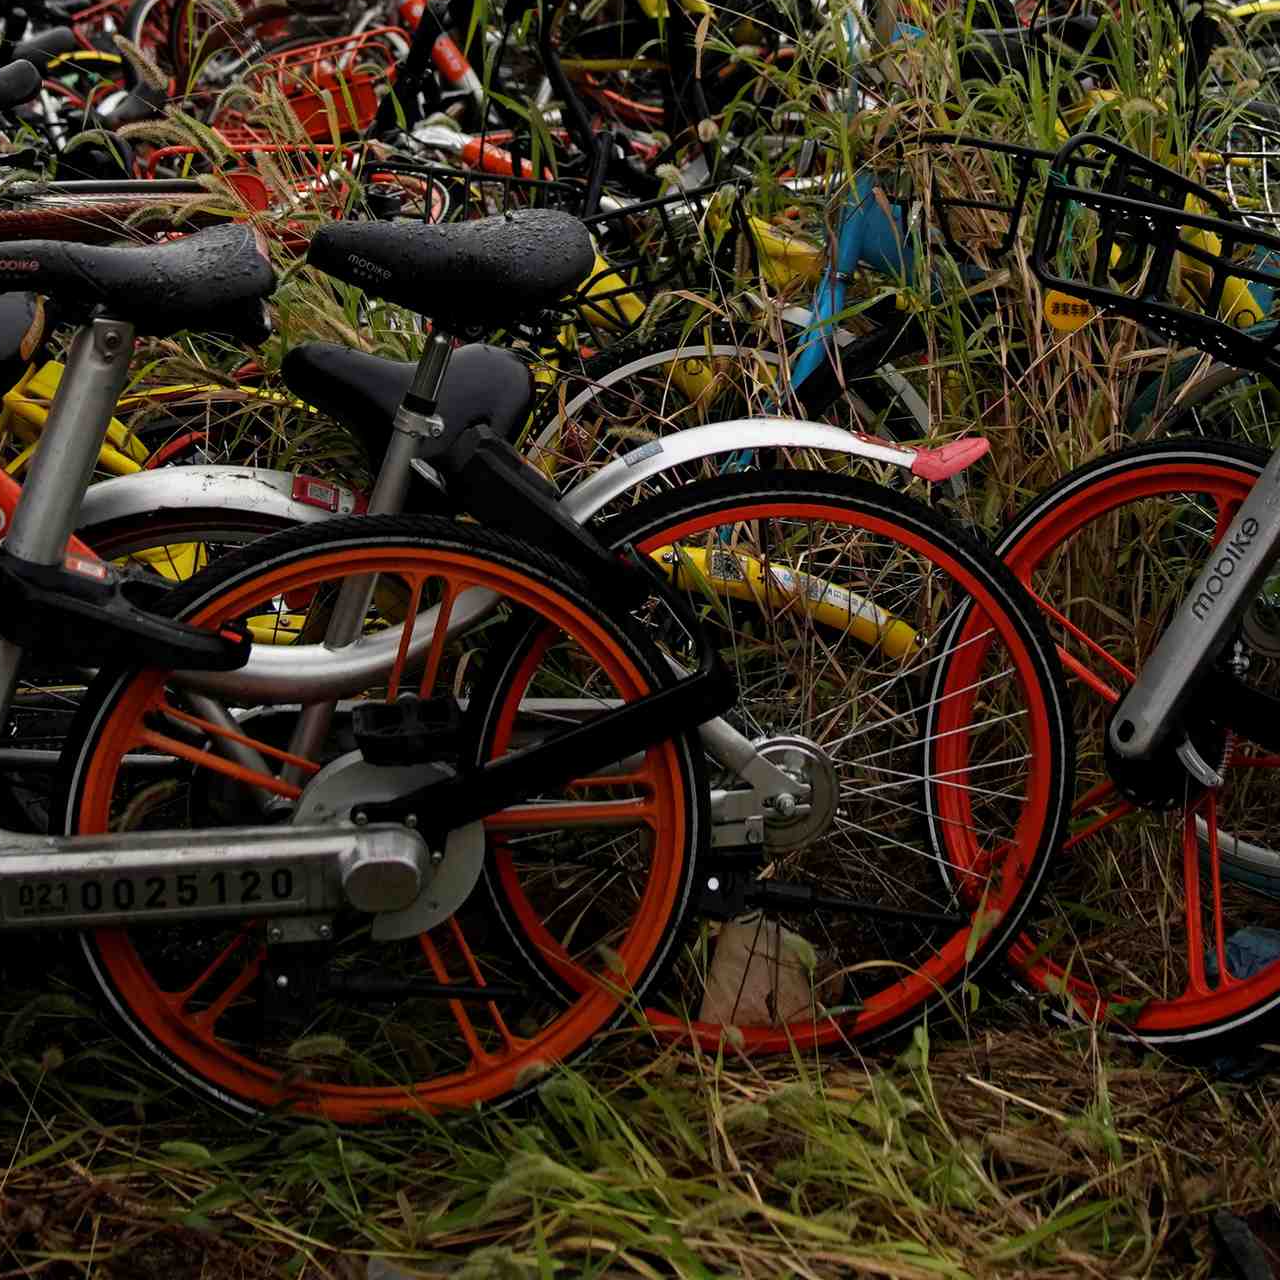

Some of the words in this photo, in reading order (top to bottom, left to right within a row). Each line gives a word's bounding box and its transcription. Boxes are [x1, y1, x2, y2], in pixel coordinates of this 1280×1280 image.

[347, 253, 393, 280] mobike
[1191, 518, 1259, 621] mobike
[20, 882, 68, 906] 021
[81, 869, 293, 911] 0025120
